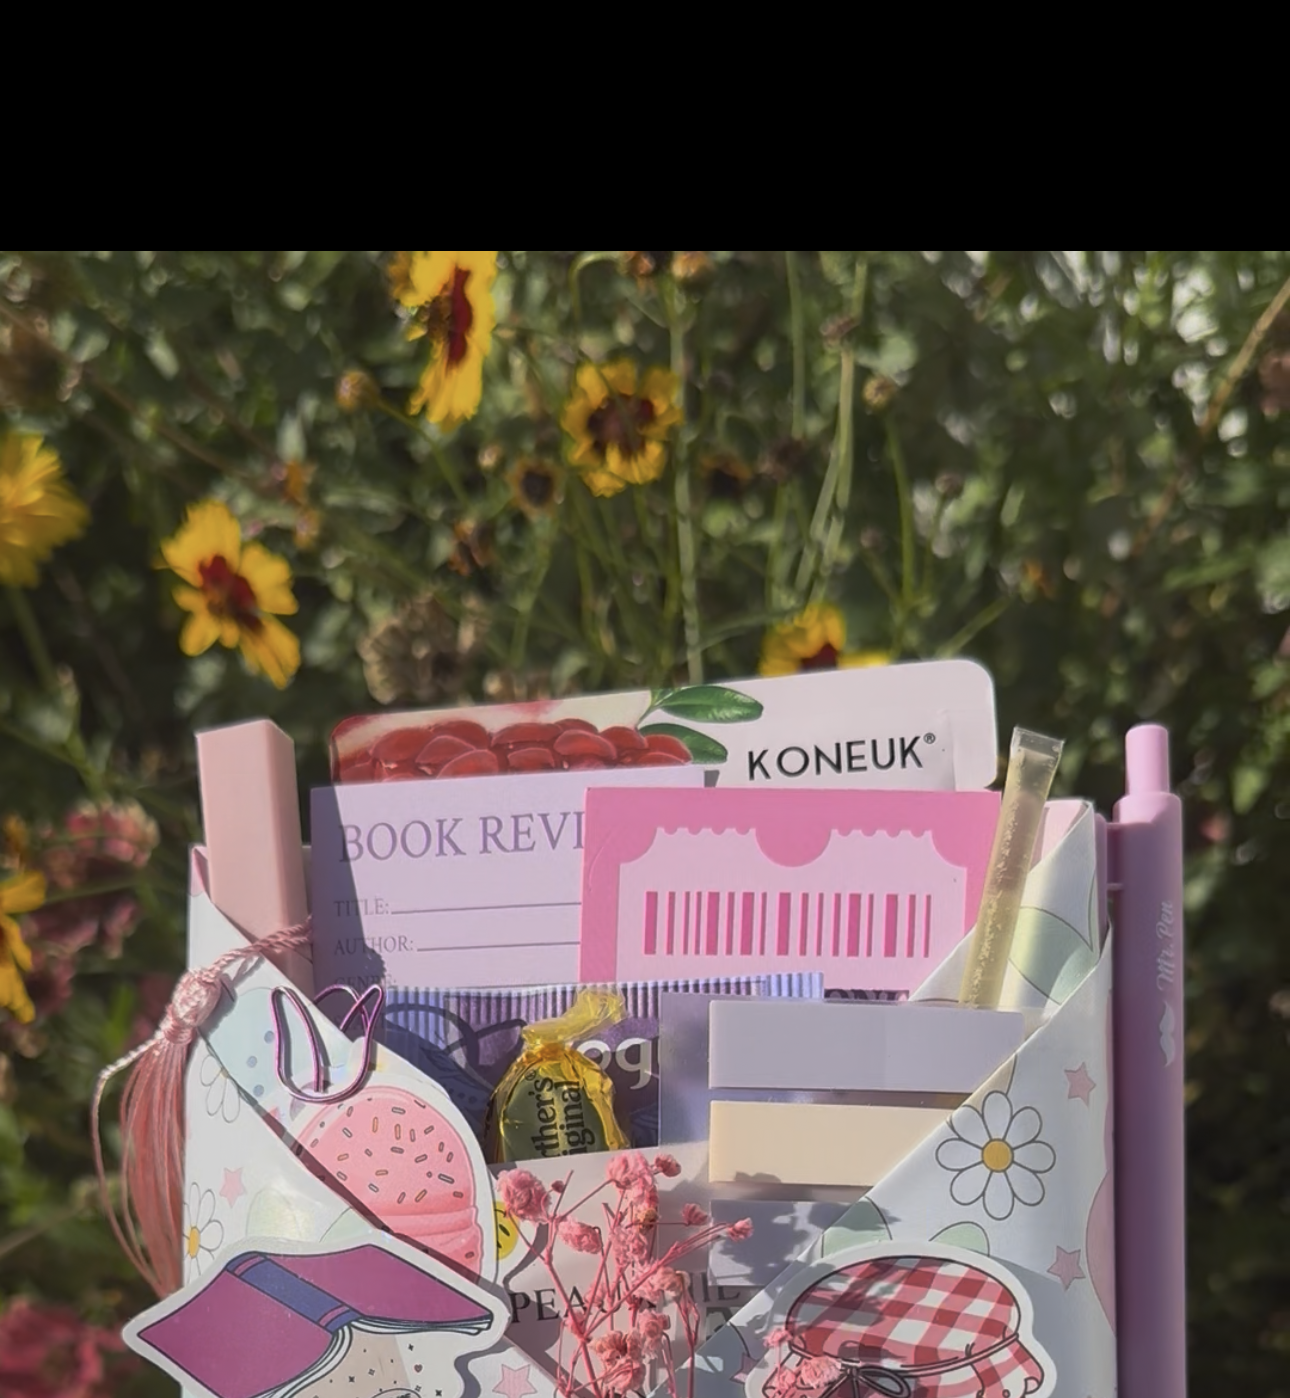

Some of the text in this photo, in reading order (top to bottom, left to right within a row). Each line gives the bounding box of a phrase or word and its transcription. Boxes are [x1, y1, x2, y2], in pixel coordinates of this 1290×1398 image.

[338, 811, 584, 863] BOOK REVI
[334, 898, 390, 917] TITLE:
[334, 935, 414, 956] AUTHOR:
[1156, 901, 1175, 991] Mr. Pen
